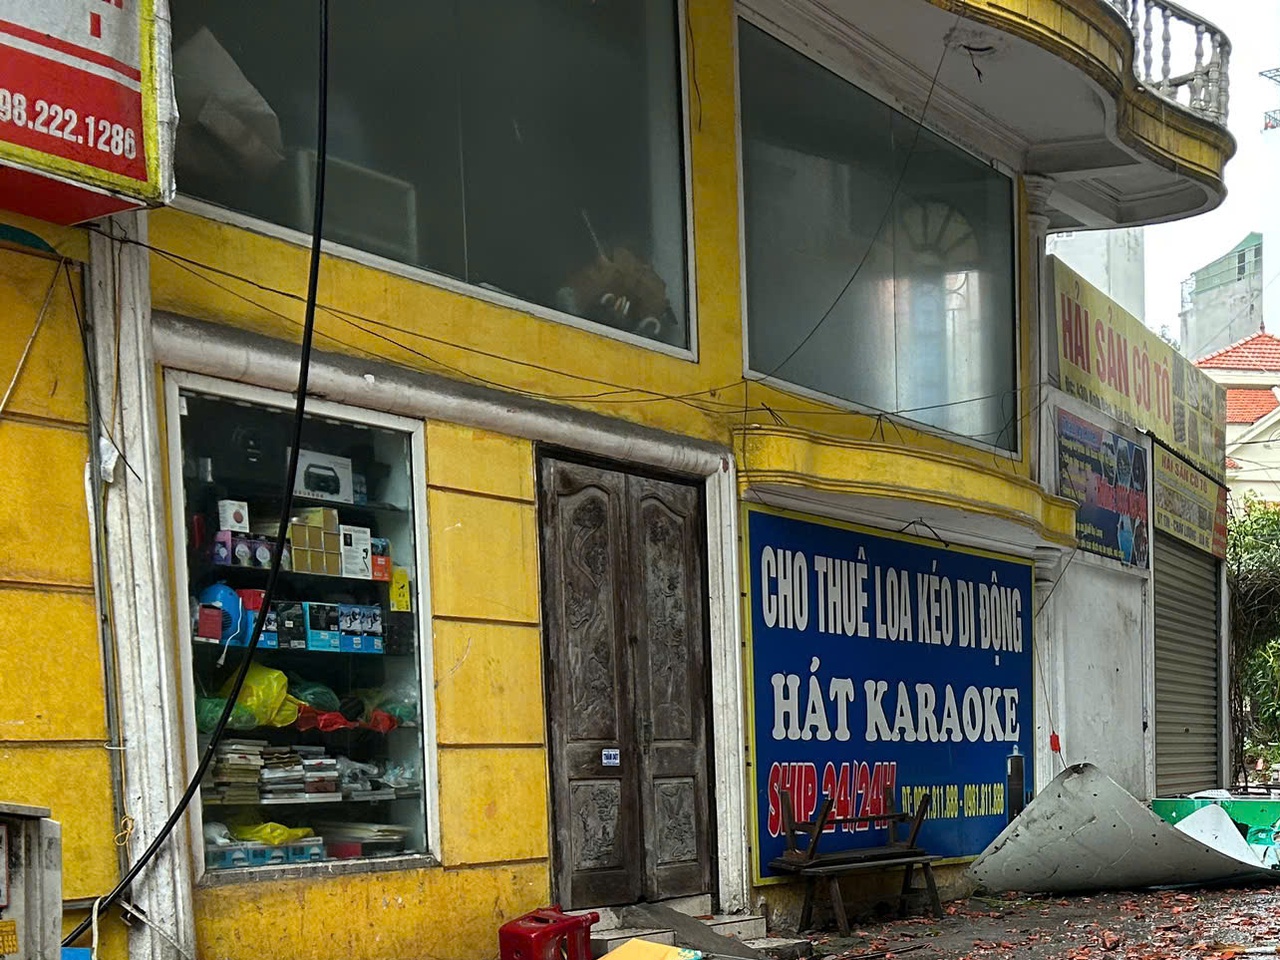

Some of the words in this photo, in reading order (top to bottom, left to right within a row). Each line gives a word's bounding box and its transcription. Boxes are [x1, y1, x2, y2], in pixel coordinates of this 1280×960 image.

[1061, 280, 1091, 375] HẢI
[1095, 305, 1130, 398] SẢN
[1132, 341, 1150, 412] CÔ
[1153, 356, 1171, 425] TÔ
[761, 545, 809, 631] CHO
[814, 546, 869, 637] THUÊ
[875, 565, 913, 641] LOA
[917, 560, 953, 646] KÉO
[957, 579, 976, 648] DI
[978, 570, 1023, 666] ĐỘNG
[771, 656, 854, 741] HÁT
[864, 680, 1020, 742] KARAOKE
[768, 761, 818, 838] SHIP
[822, 760, 897, 834] 24/24H
